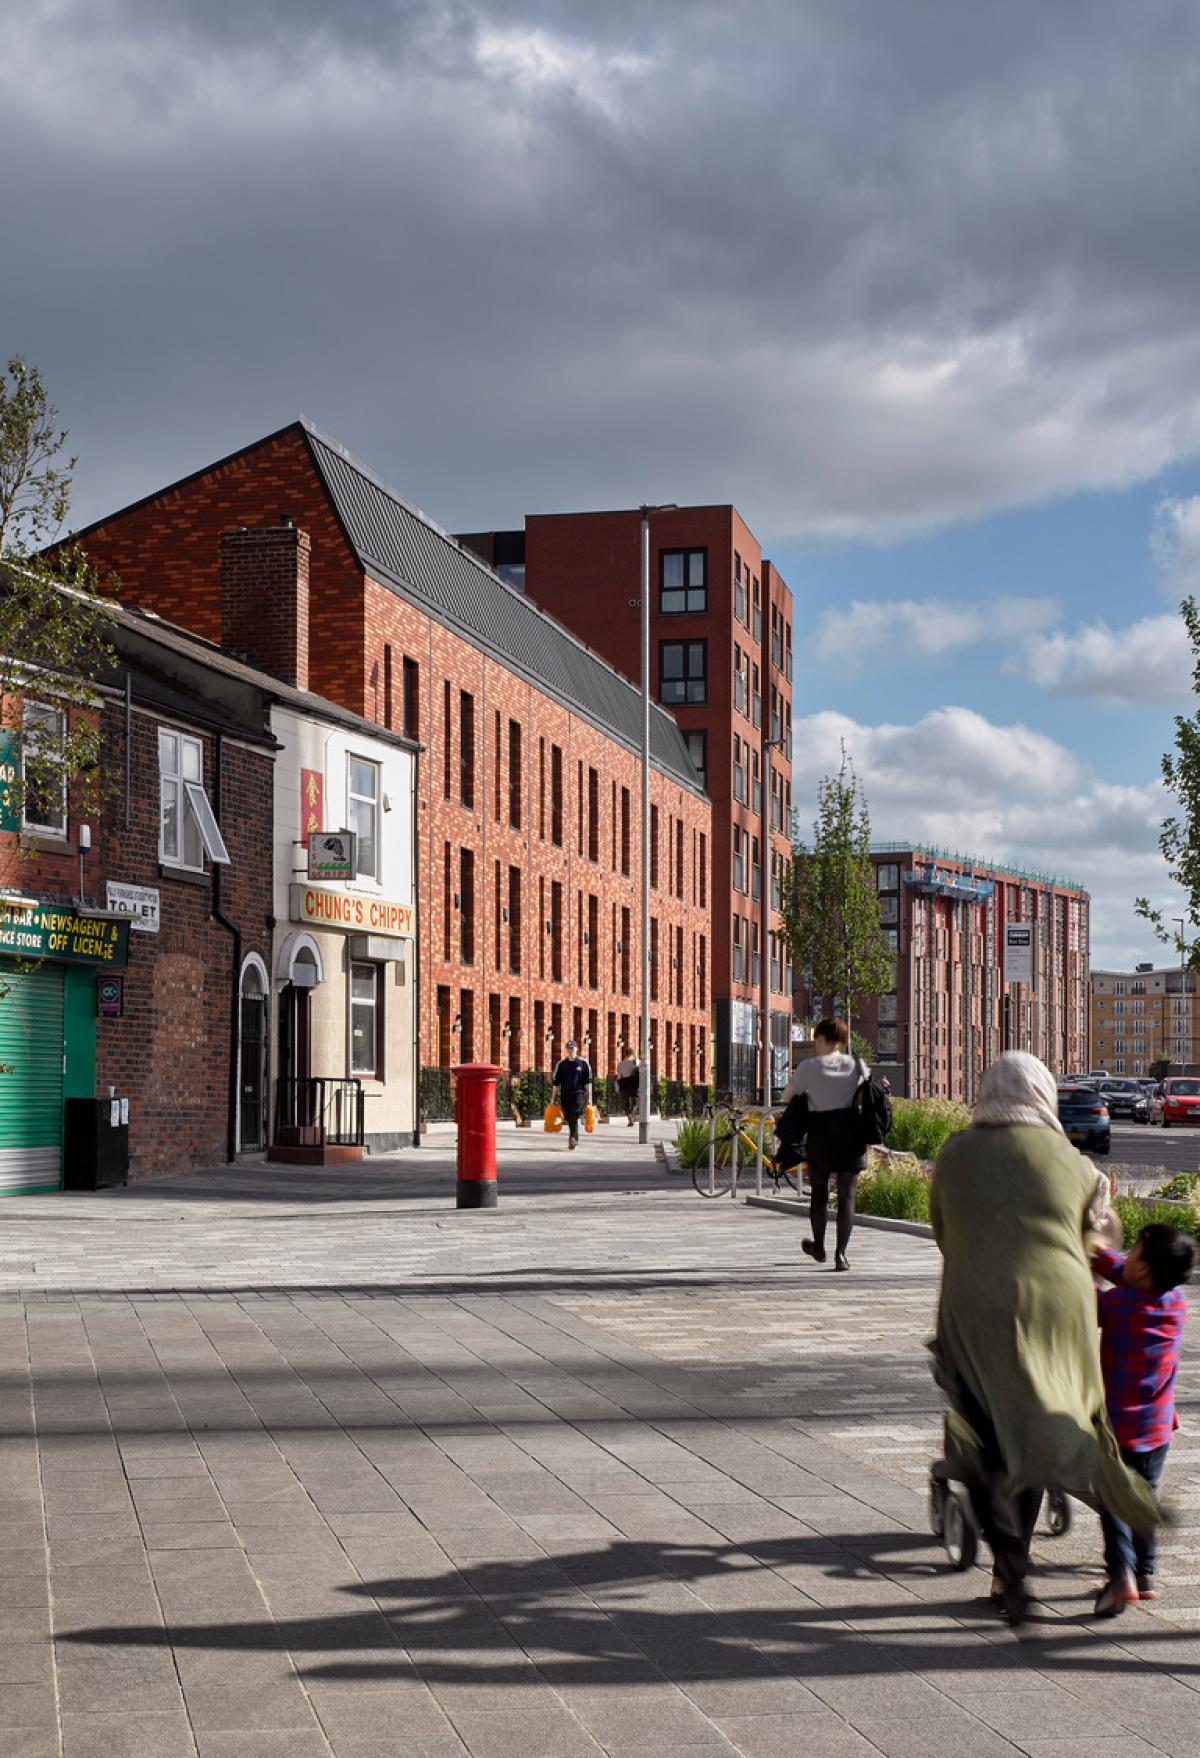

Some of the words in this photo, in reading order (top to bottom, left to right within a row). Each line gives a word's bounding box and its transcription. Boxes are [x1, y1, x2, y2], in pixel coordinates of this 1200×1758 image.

[305, 890, 364, 924] CHUNG'S
[369, 902, 412, 931] CHIPPY
[16, 932, 42, 948] STORE
[48, 933, 69, 951] OFF
[40, 912, 107, 938] NEWSAGENT
[110, 925, 119, 942] &
